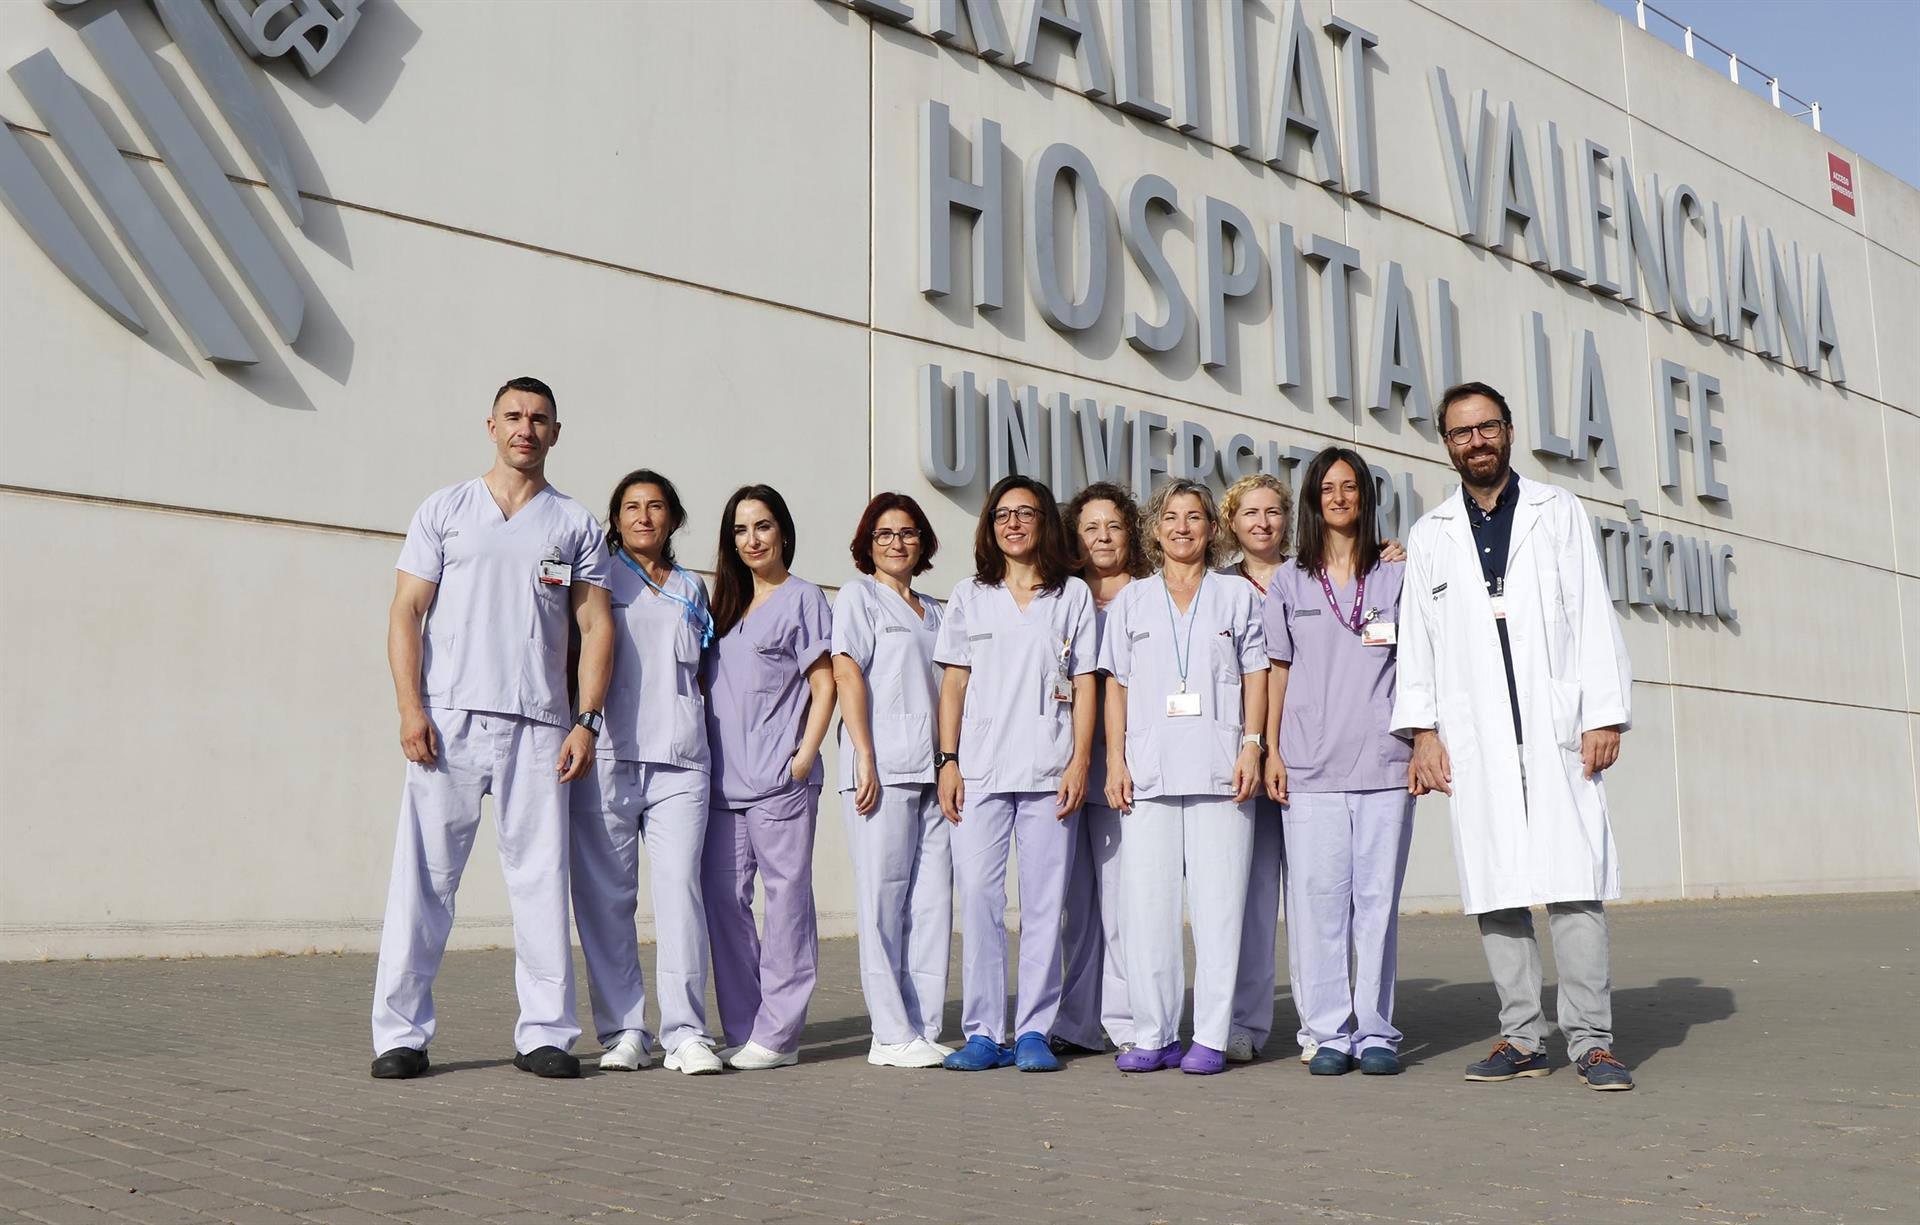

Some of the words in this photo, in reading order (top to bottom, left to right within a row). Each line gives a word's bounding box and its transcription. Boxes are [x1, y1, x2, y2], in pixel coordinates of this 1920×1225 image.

[918, 99, 1456, 421] HOSPITAL
[1523, 310, 1618, 471] LA
[1654, 357, 1729, 502] FE
[1428, 66, 1846, 384] VALENCIANA
